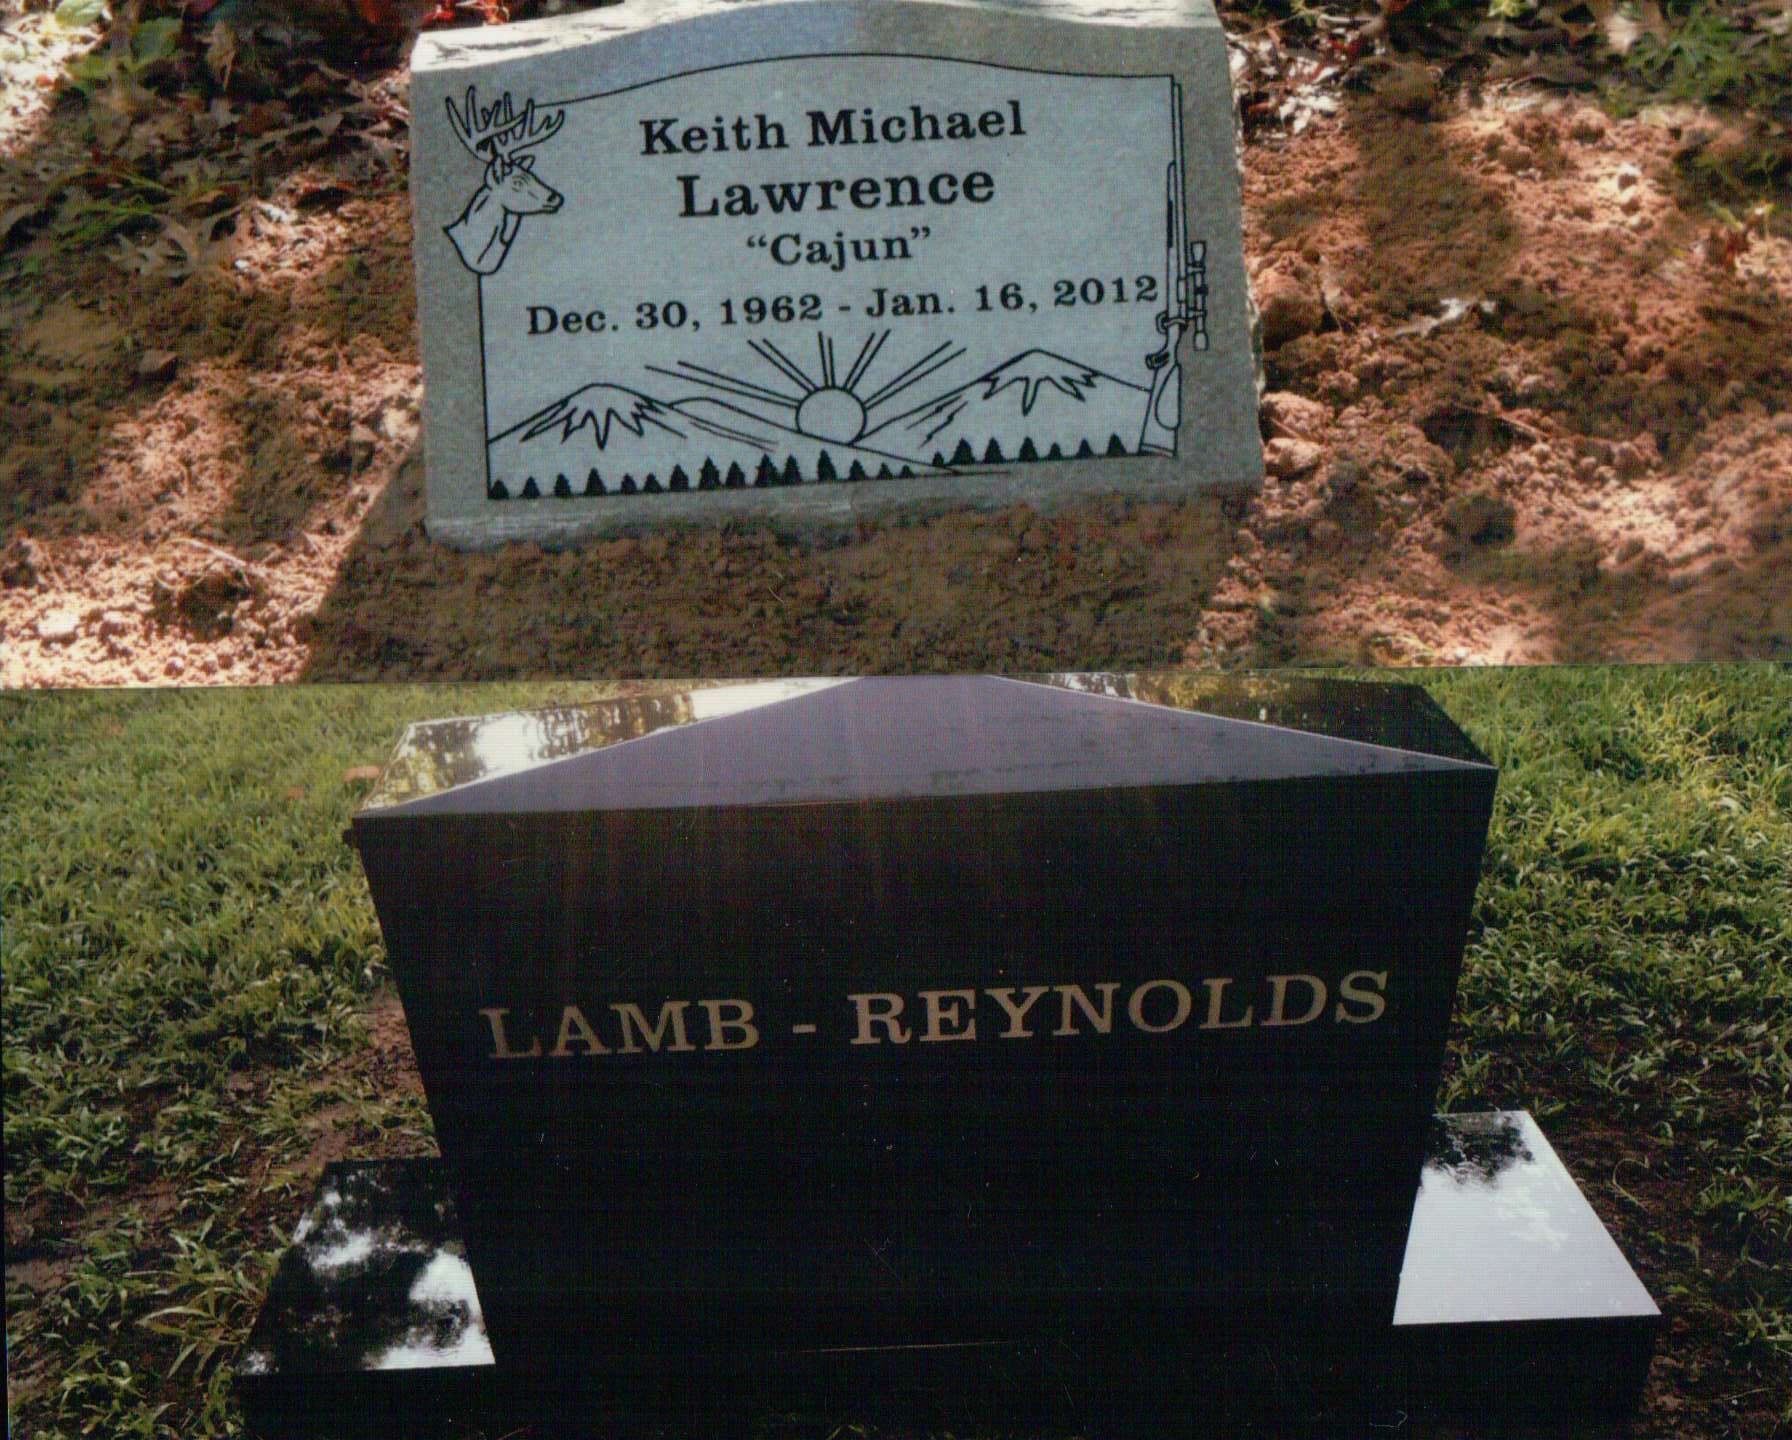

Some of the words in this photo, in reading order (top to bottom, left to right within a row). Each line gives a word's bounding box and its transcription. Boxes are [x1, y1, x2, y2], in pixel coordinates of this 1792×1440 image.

[638, 113, 790, 156] Keith
[805, 99, 1027, 147] Michael
[676, 170, 995, 218] Lawrence
[746, 225, 931, 273] “Cajun”
[525, 305, 619, 336] Dec.
[635, 300, 701, 332] 30,
[720, 293, 823, 326] 1962
[865, 287, 955, 318] Jan.
[975, 282, 1038, 313] 16,
[1053, 274, 1158, 307] 2012
[478, 998, 760, 1059] LAMB
[792, 1023, 817, 1034] -
[847, 970, 1388, 1045] REYNOLDS
